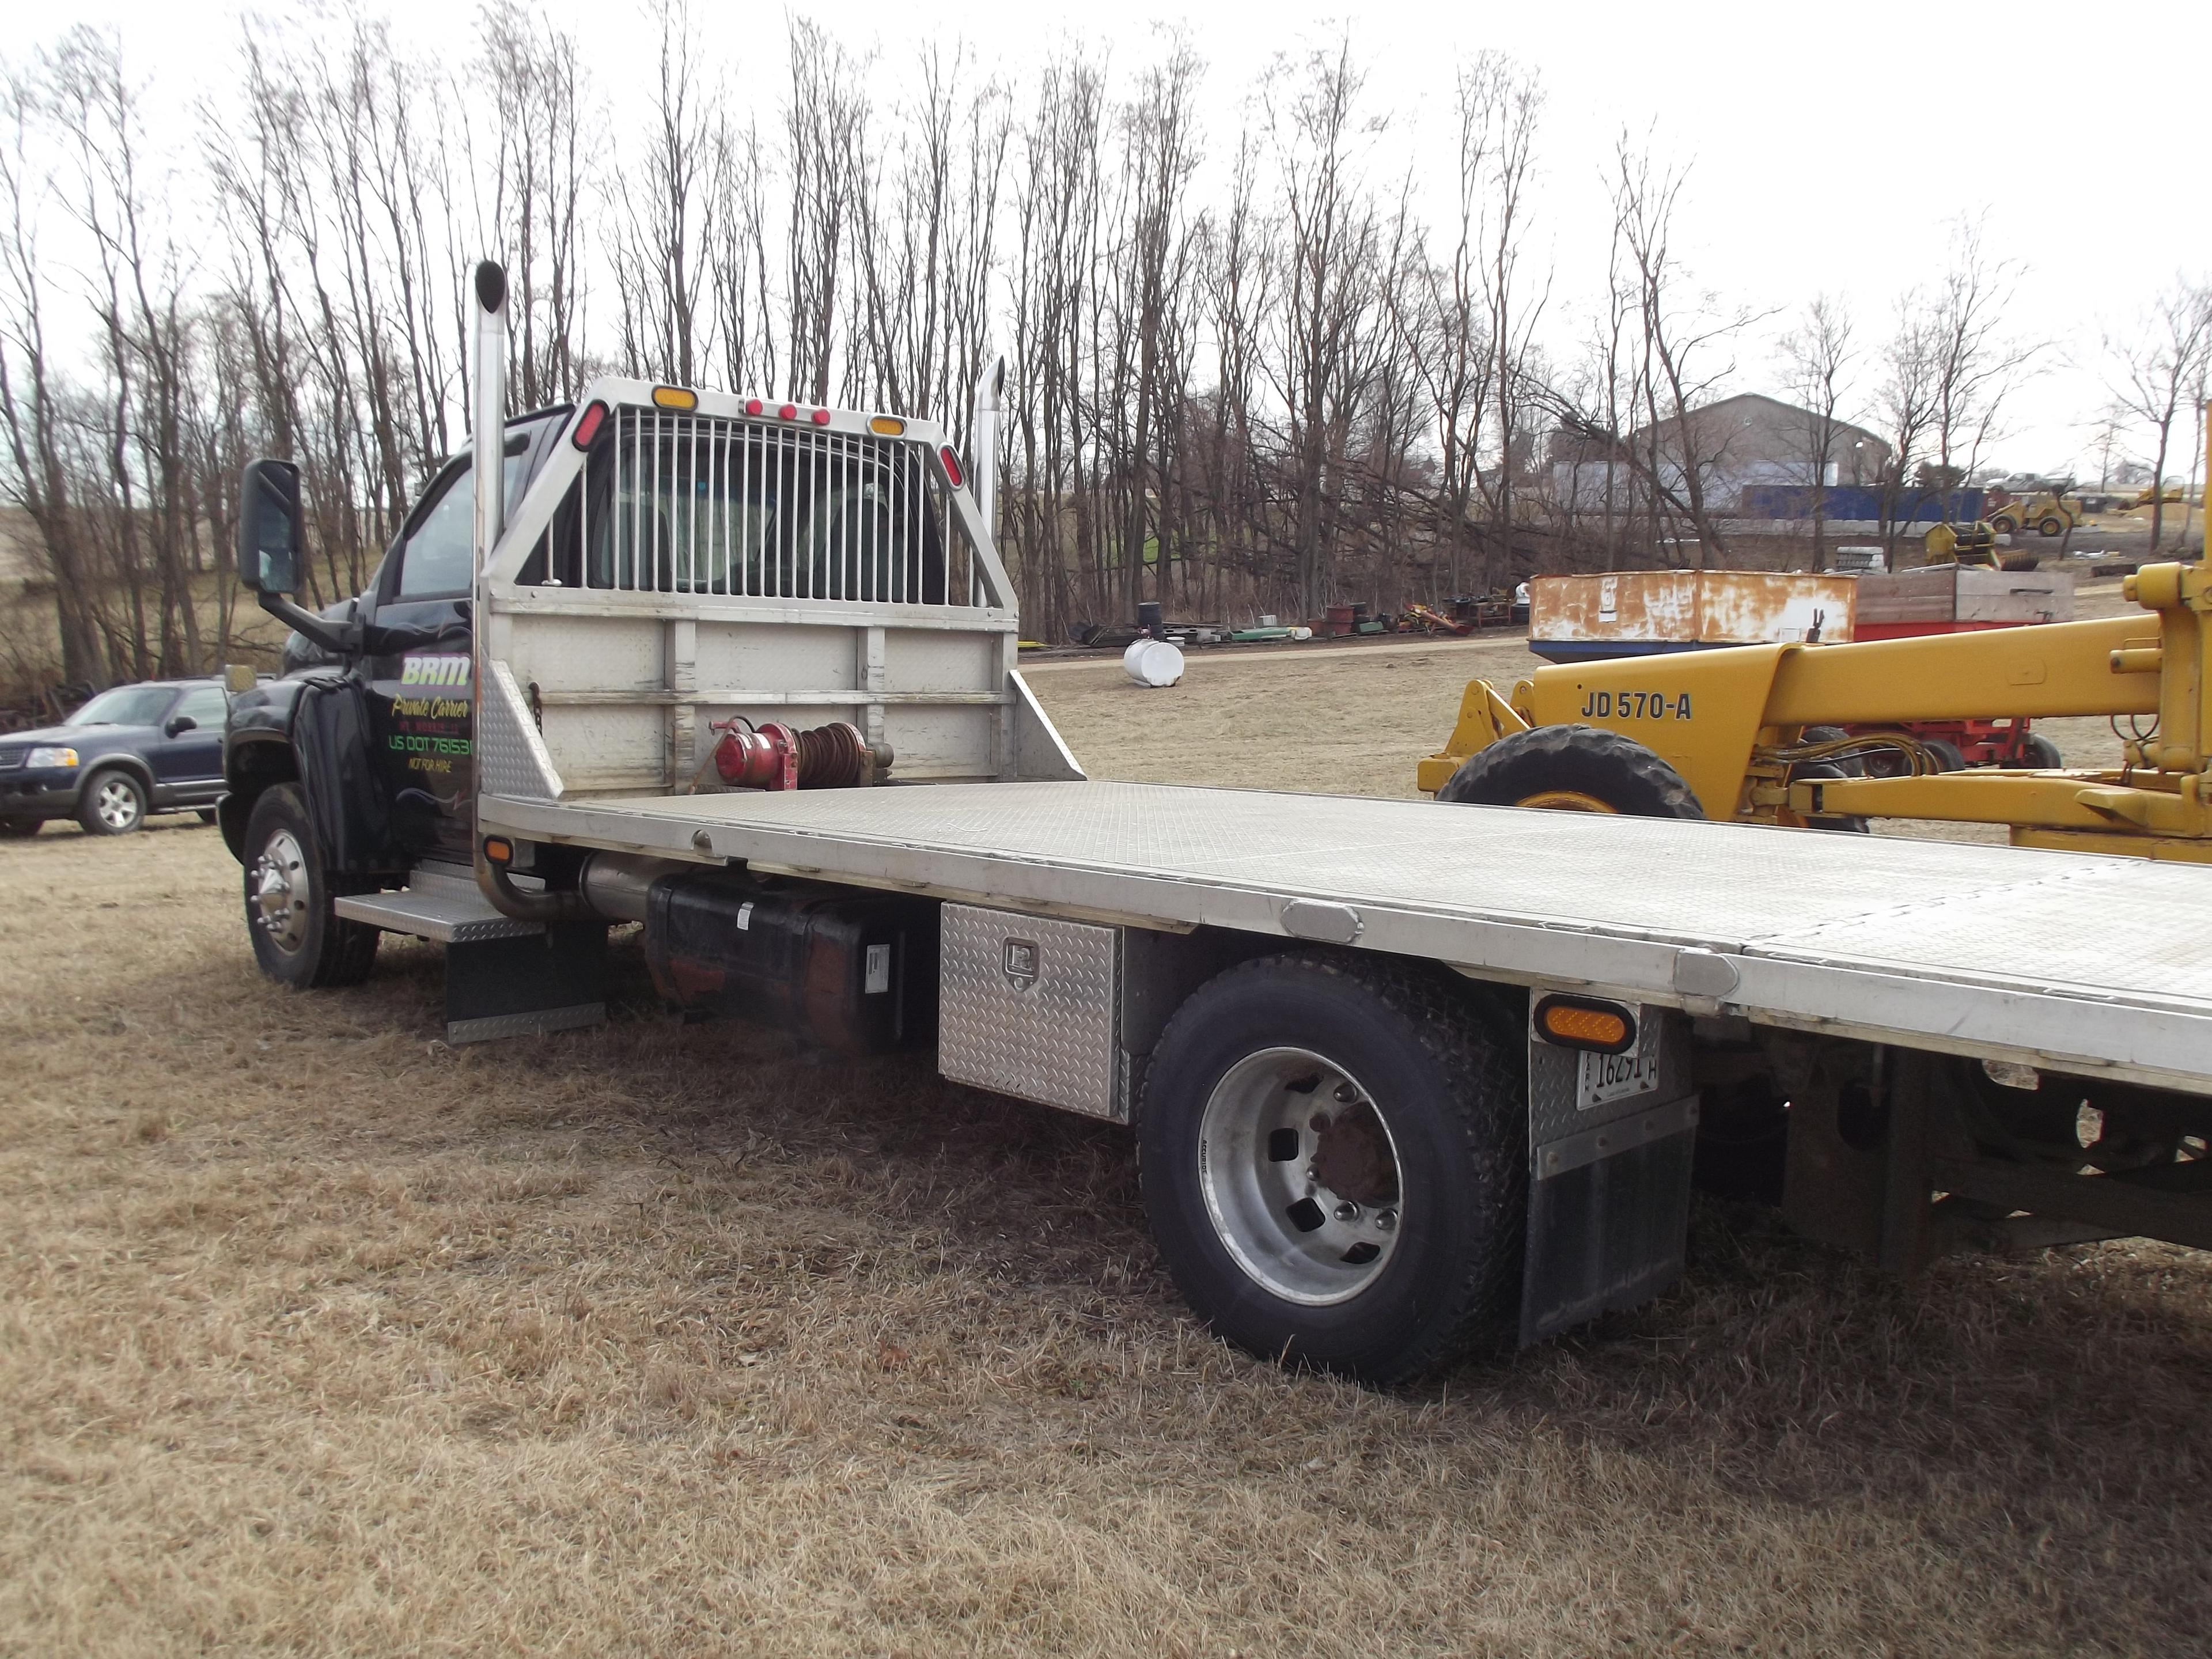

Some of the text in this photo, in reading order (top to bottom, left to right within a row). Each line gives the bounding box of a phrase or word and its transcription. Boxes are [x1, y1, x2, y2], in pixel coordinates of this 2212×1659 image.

[392, 693, 468, 719] Private Carrier
[1581, 692, 1692, 720] JD 570-A
[388, 735, 404, 750] US
[406, 736, 430, 751] DOT
[408, 757, 452, 773] NOT FOR HIRE
[1648, 1059, 1657, 1081] H
